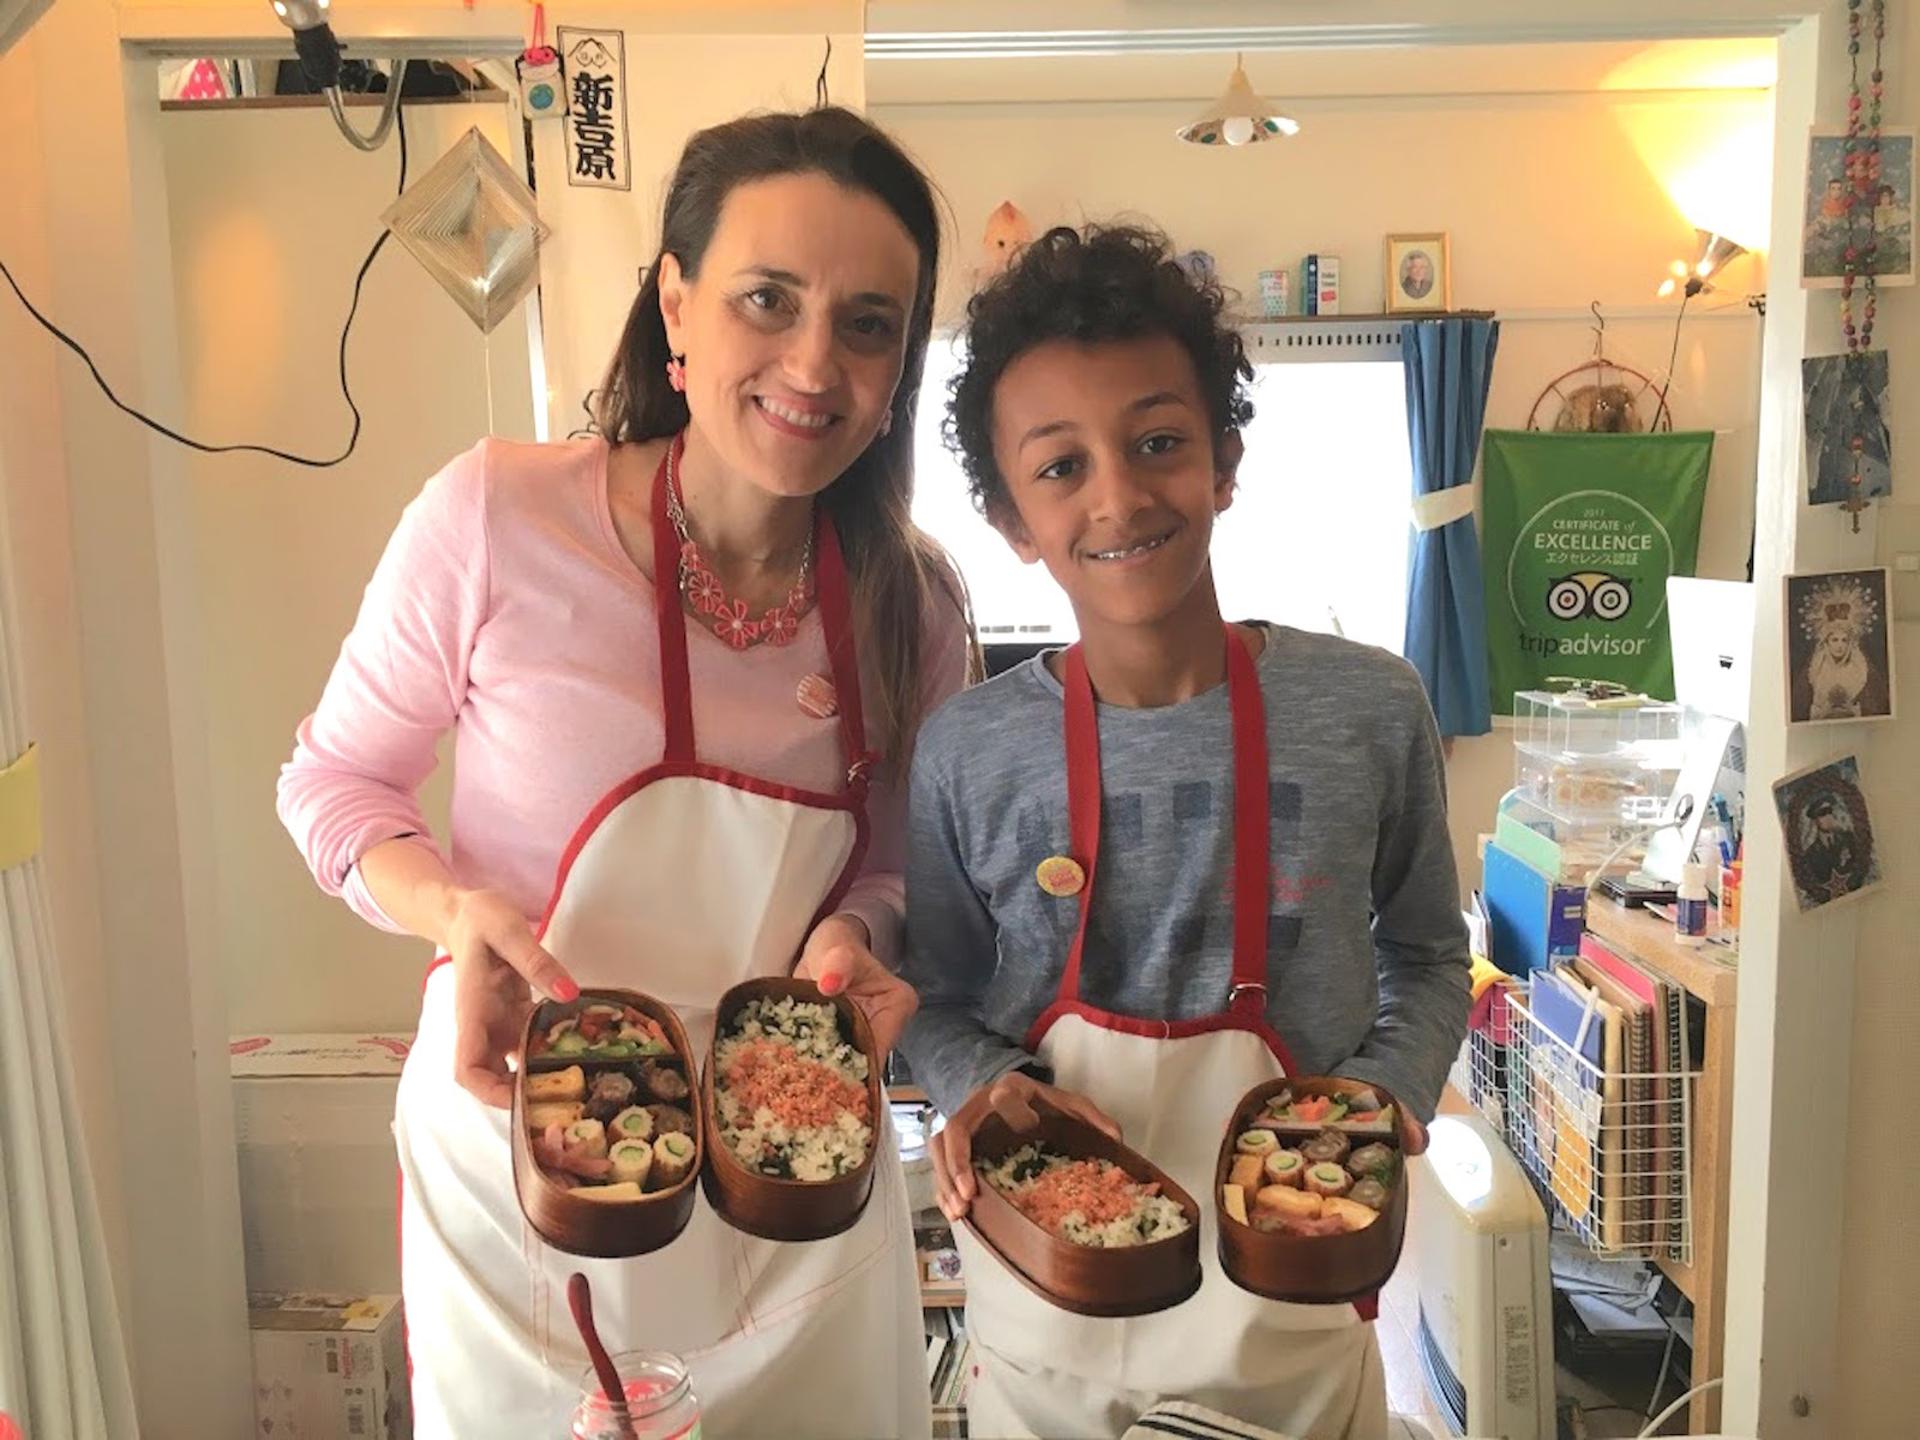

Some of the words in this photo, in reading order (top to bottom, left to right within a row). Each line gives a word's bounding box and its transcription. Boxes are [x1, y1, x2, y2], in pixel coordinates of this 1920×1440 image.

[572, 71, 616, 180] 新吉原
[1552, 519, 1620, 531] CERTIFICATE
[1624, 520, 1636, 533] of
[1534, 533, 1652, 550] EXCELLENCE
[1519, 631, 1646, 658] tripadvisor
